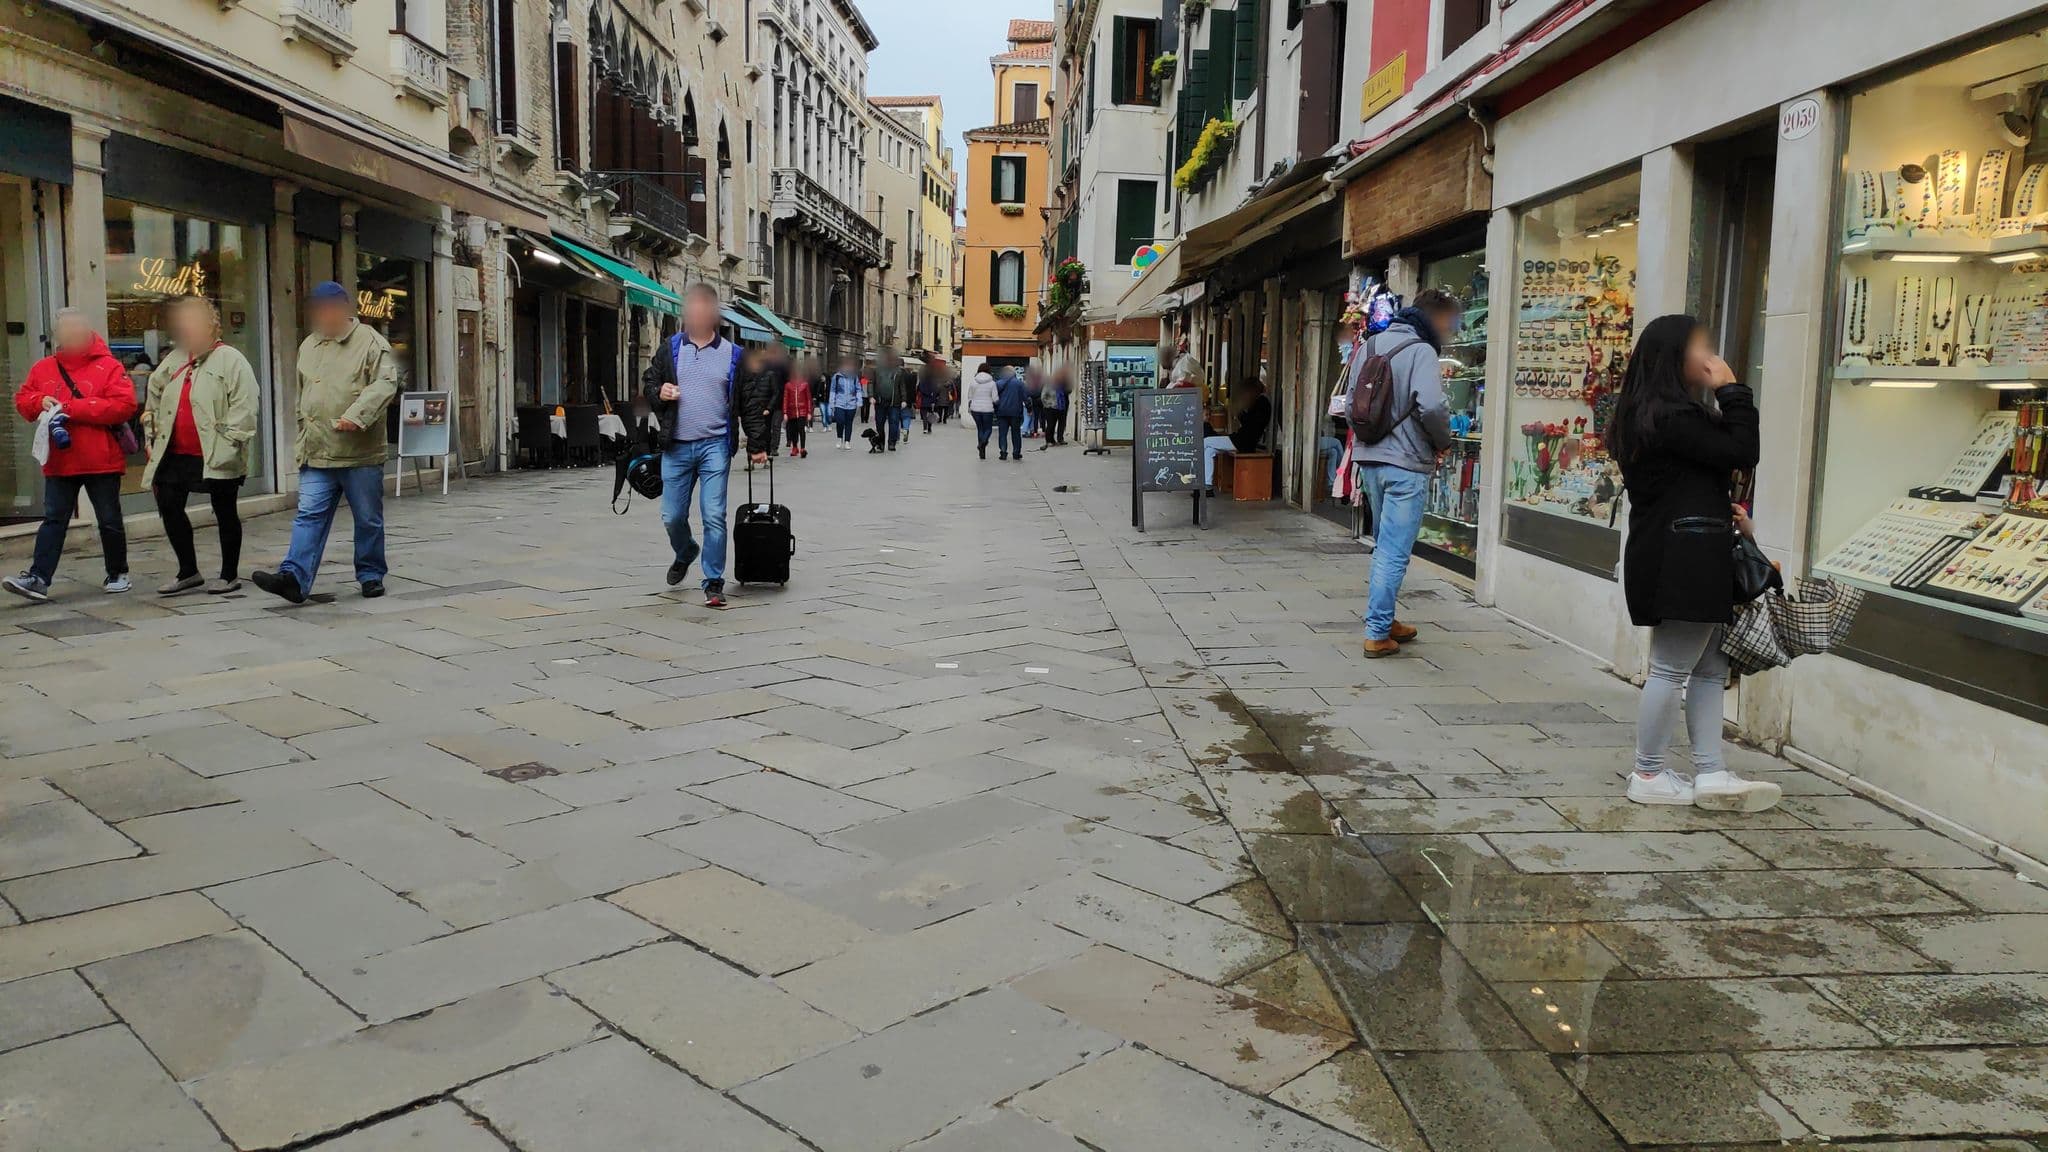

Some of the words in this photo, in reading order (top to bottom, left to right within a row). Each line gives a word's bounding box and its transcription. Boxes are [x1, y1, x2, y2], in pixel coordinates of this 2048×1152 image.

[1783, 105, 1816, 134] 2059
[133, 257, 191, 295] Lindt
[357, 290, 387, 318] Lindt
